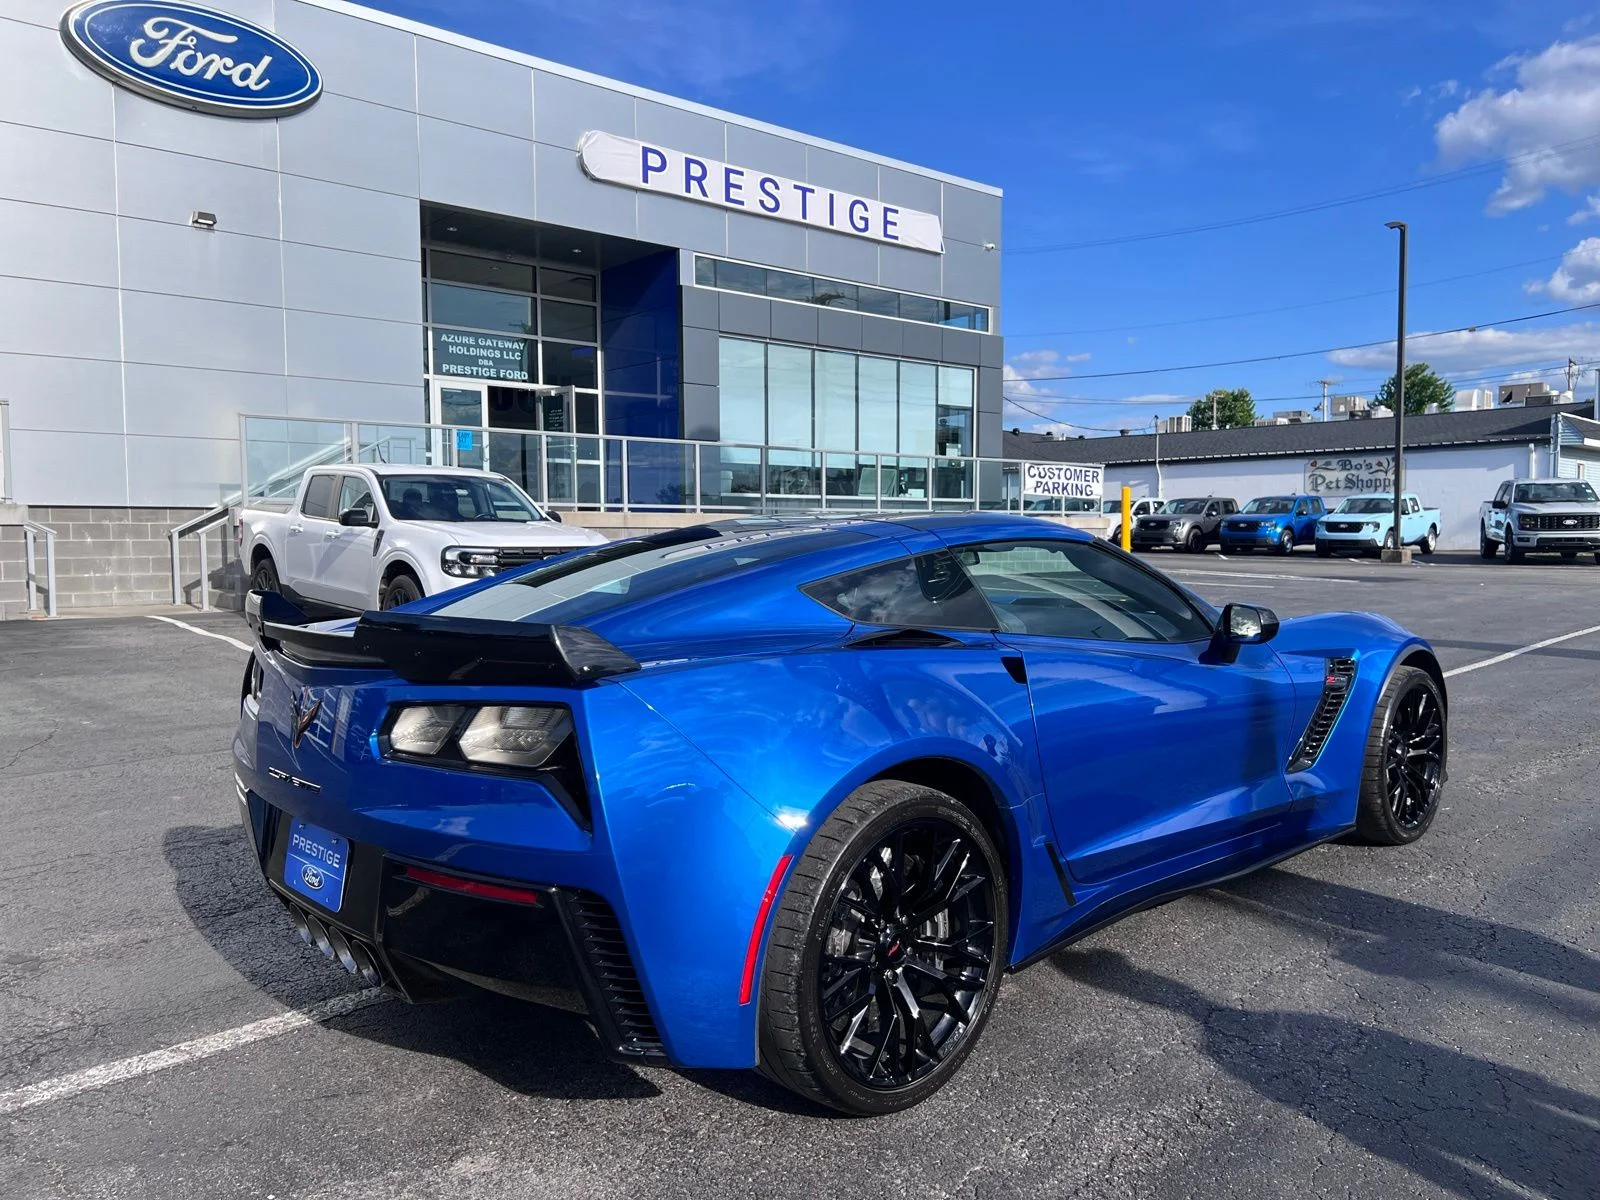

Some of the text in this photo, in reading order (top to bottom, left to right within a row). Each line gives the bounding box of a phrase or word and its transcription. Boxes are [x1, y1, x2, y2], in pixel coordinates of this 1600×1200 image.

[129, 16, 273, 91] Ford
[641, 145, 900, 241] PRESTIGE
[441, 334, 525, 350] AZURE GATEWAY
[449, 345, 501, 358] HOLDINGS
[478, 358, 494, 367] DBA
[443, 364, 528, 380] PRESTIGE FORD
[1337, 459, 1373, 471] Bo's
[1028, 466, 1099, 483] CUSTOMER
[1034, 481, 1093, 496] PARKING
[1308, 473, 1395, 493] Pet Shopp
[293, 834, 340, 868] PRESTIGE
[303, 866, 322, 888] Ford
